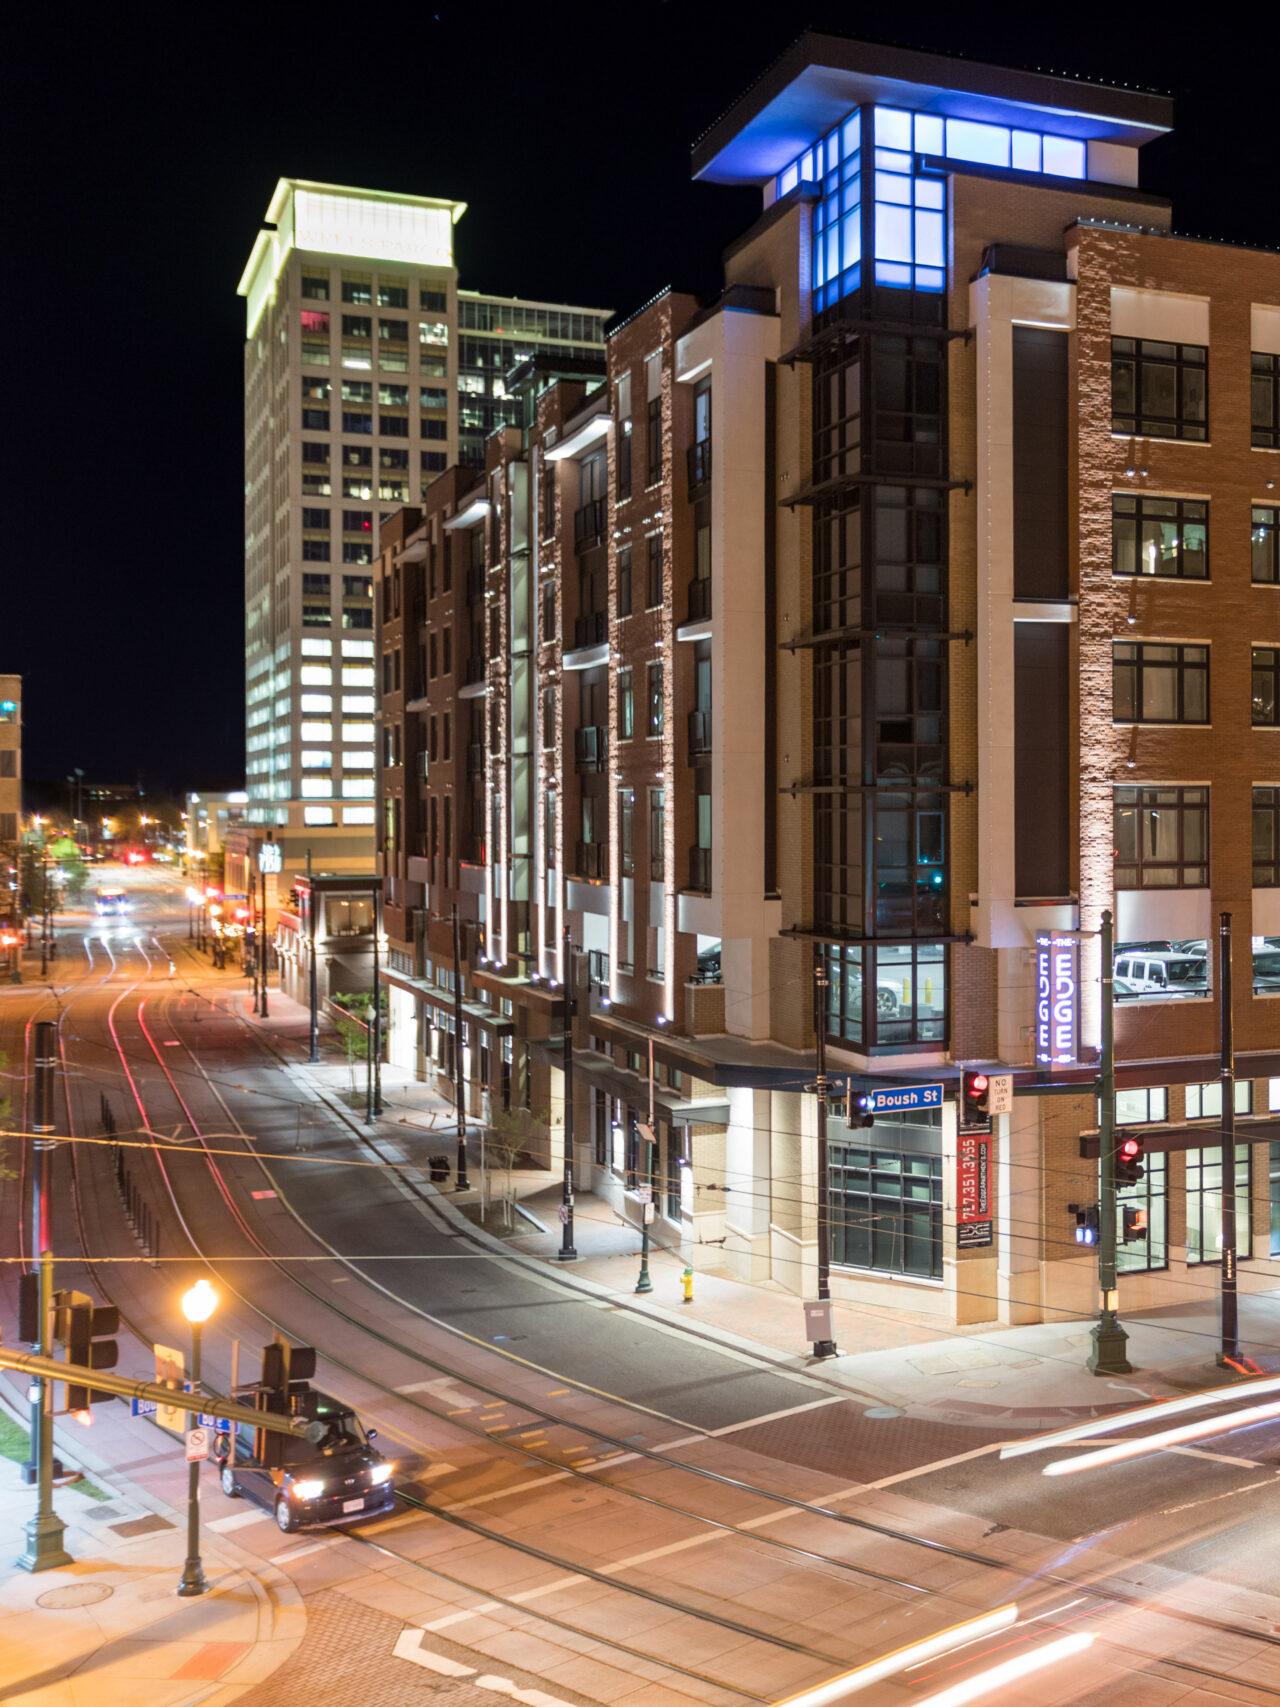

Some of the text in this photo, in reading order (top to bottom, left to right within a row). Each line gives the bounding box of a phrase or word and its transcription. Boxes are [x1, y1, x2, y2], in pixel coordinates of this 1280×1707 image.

[1039, 953, 1050, 1047] EDGE
[1054, 953, 1074, 1048] EDGE
[995, 1078, 1006, 1087] NO
[877, 1090, 938, 1107] Boush St
[995, 1103, 1006, 1111] RED
